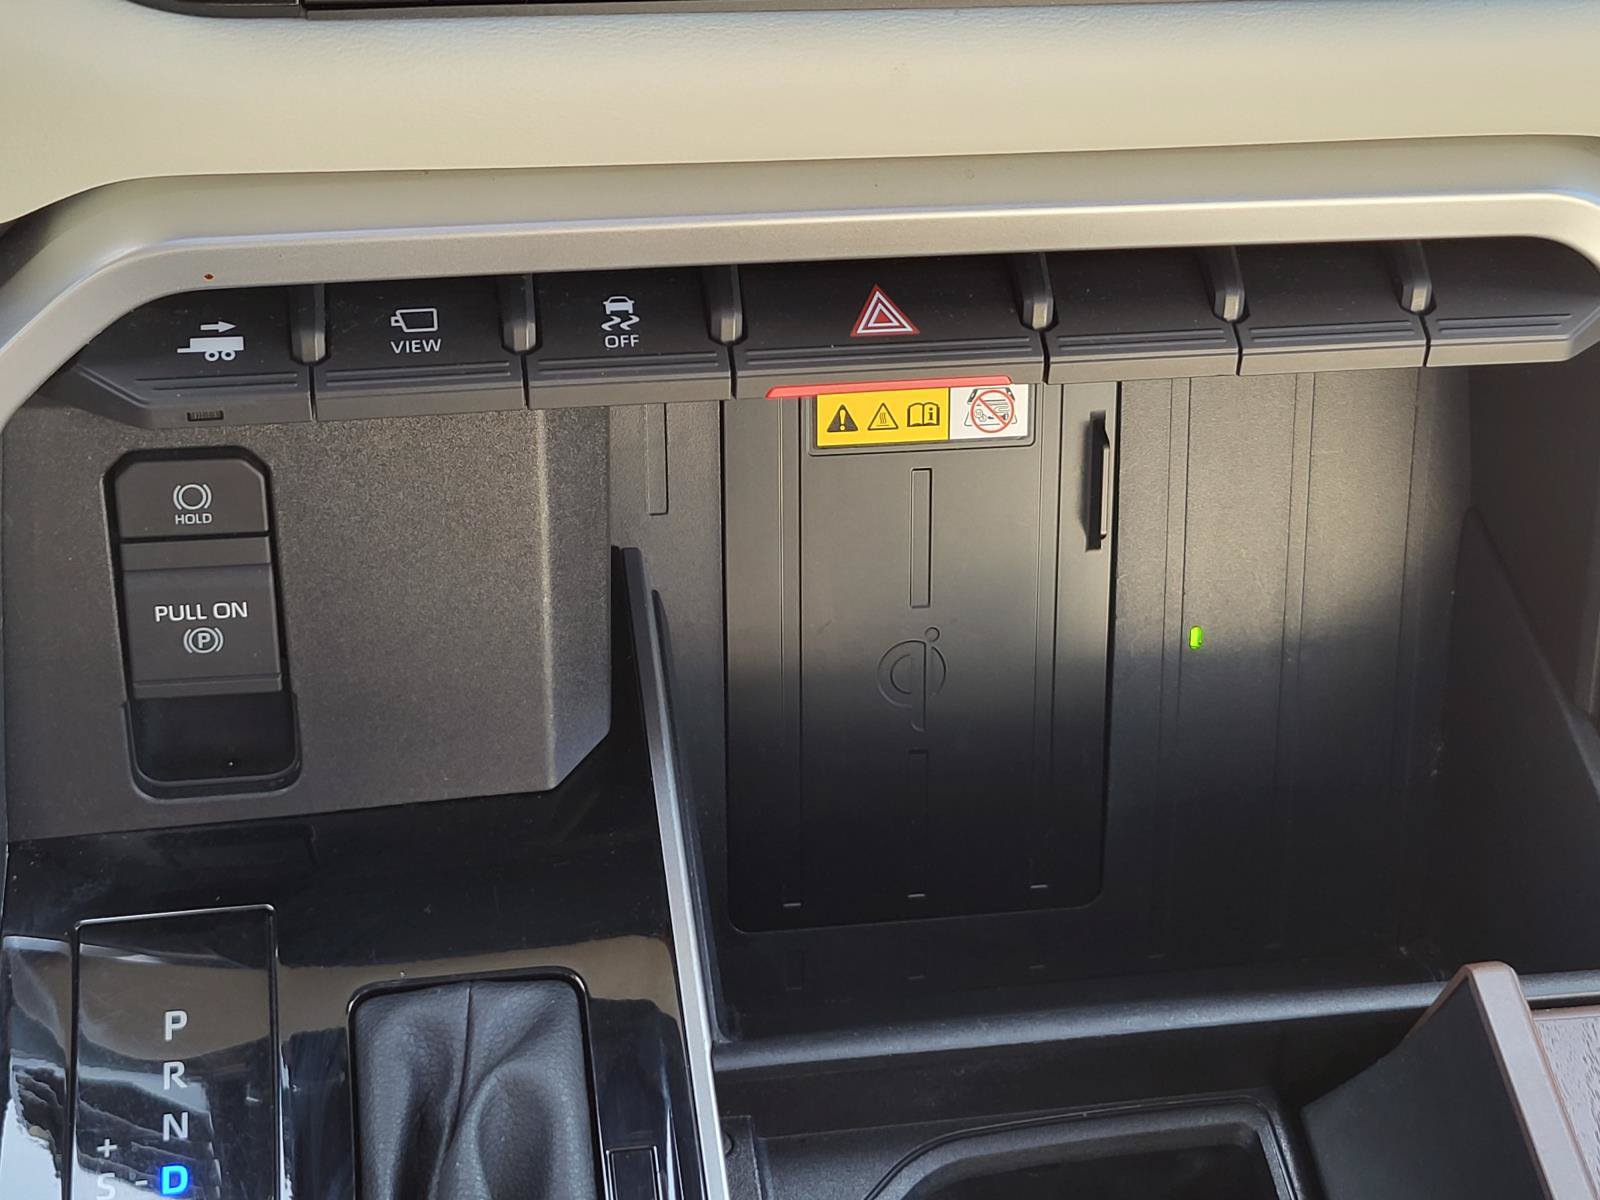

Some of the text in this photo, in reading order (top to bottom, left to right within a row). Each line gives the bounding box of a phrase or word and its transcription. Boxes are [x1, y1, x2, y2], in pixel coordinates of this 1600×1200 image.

[390, 338, 441, 354] VIEW
[604, 334, 640, 348] OFF
[175, 512, 213, 525] HOLD
[154, 602, 249, 622] PULL ON
[163, 1010, 188, 1041] P
[163, 1061, 188, 1090] R
[162, 1112, 189, 1141] N
[96, 1172, 116, 1200] S
[161, 1165, 189, 1195] D
